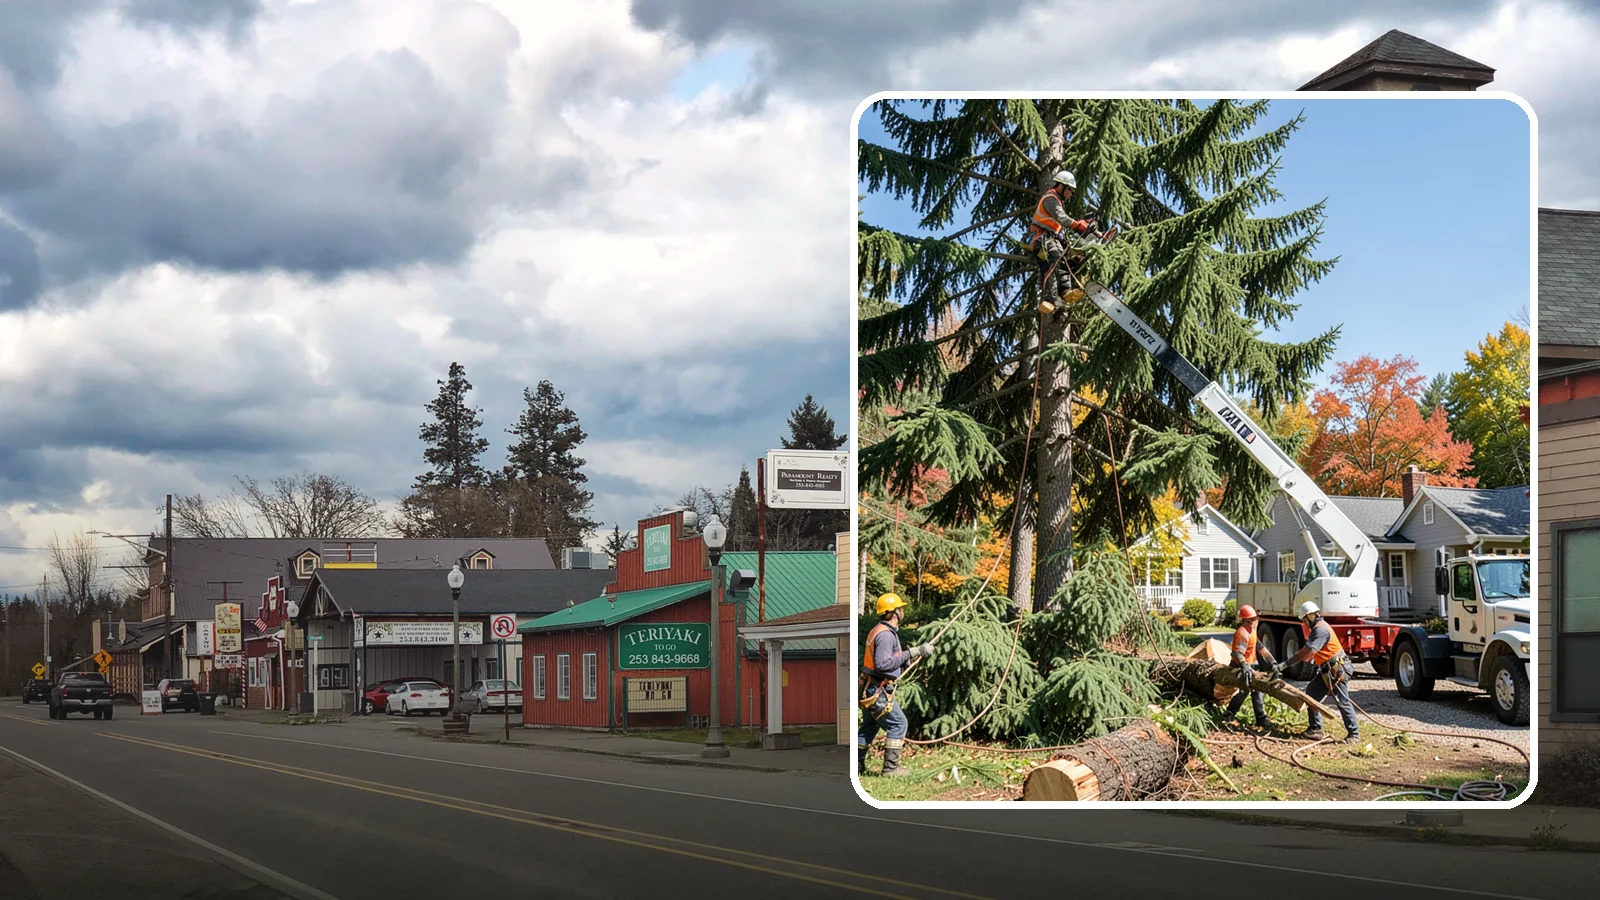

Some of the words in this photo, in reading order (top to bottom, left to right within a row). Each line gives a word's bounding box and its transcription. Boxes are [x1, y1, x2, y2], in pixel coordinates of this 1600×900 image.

[625, 628, 702, 646] TERIYAKI
[629, 654, 648, 664] 253
[652, 654, 700, 664] 843-9668
[639, 681, 672, 690] TERIYAKI
